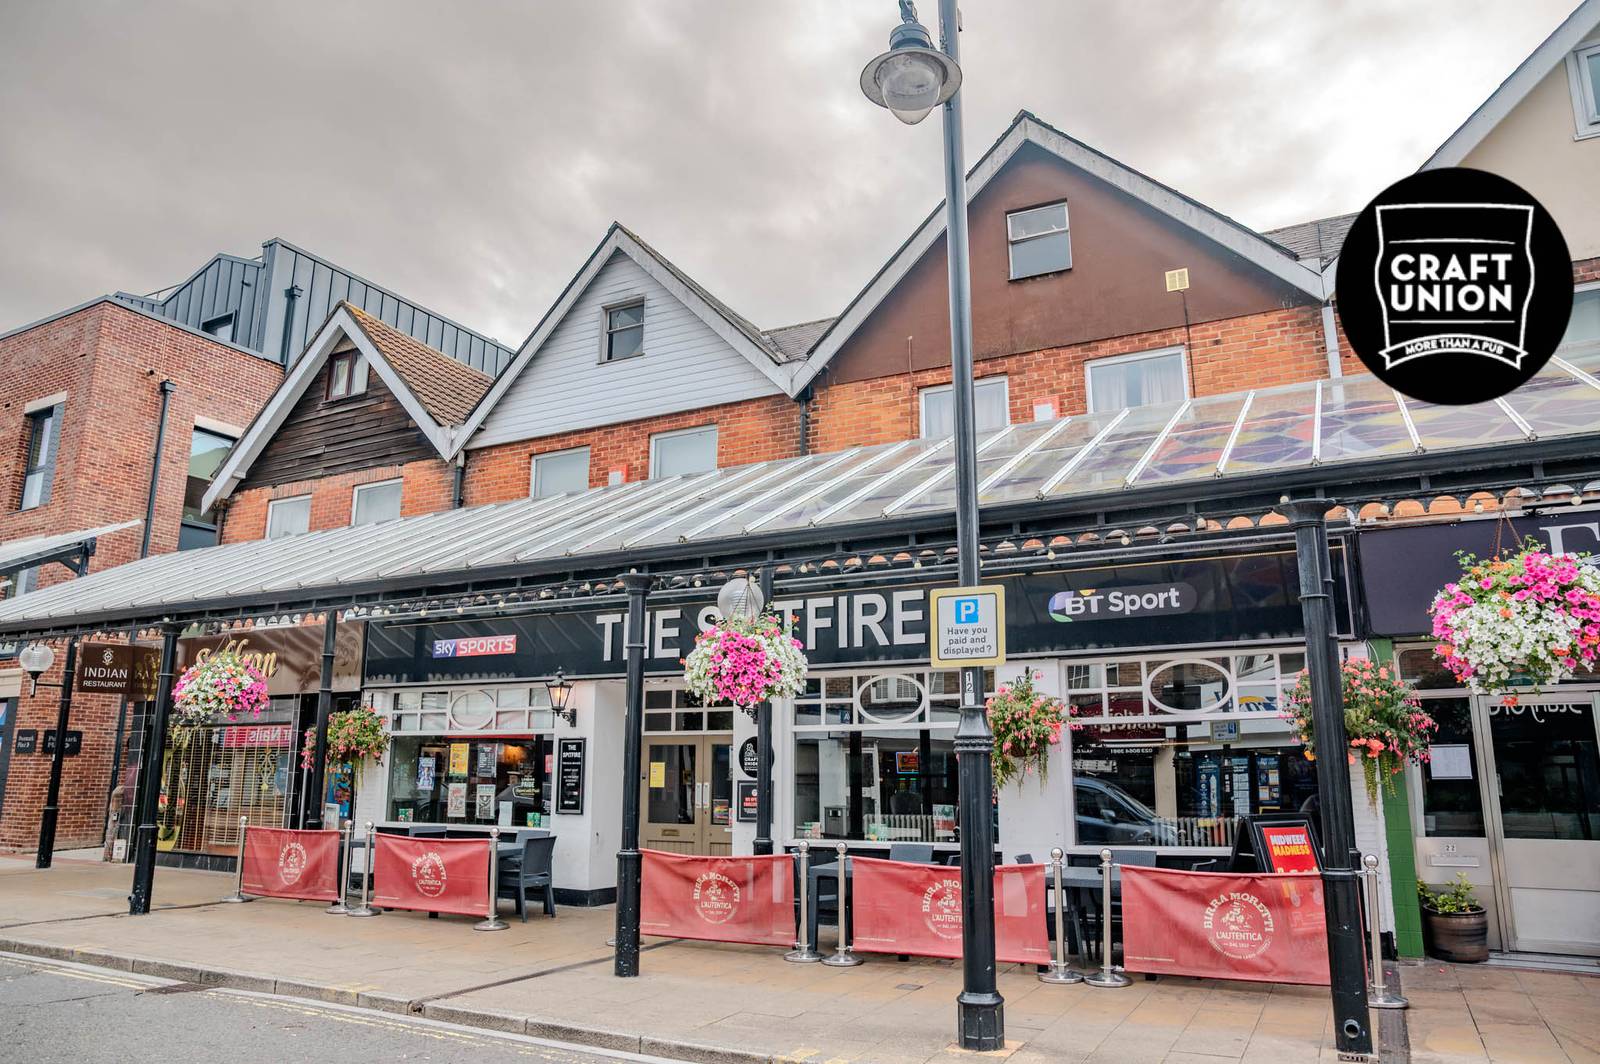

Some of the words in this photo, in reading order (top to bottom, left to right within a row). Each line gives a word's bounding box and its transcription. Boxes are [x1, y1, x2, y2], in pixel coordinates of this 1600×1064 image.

[1065, 594, 1103, 615] BT
[1108, 587, 1180, 615] Sport
[960, 601, 976, 622] P
[947, 627, 969, 635] Have
[971, 627, 988, 636] you
[948, 636, 967, 645] paid
[970, 635, 986, 644] and
[435, 641, 455, 656] sky
[459, 638, 514, 654] SPORTS
[84, 667, 128, 679] INDIAN
[82, 680, 126, 688] RESTAURANT
[1269, 834, 1307, 846] MIDWEEK
[1272, 844, 1310, 857] MADNESS
[693, 873, 708, 900] BIRRA
[709, 871, 740, 903] MORETTI
[922, 882, 943, 912] BIRRA
[1203, 894, 1229, 929] BIRRA
[1229, 892, 1275, 933] MORETTI
[1216, 931, 1263, 942] L'AUTENTICA
